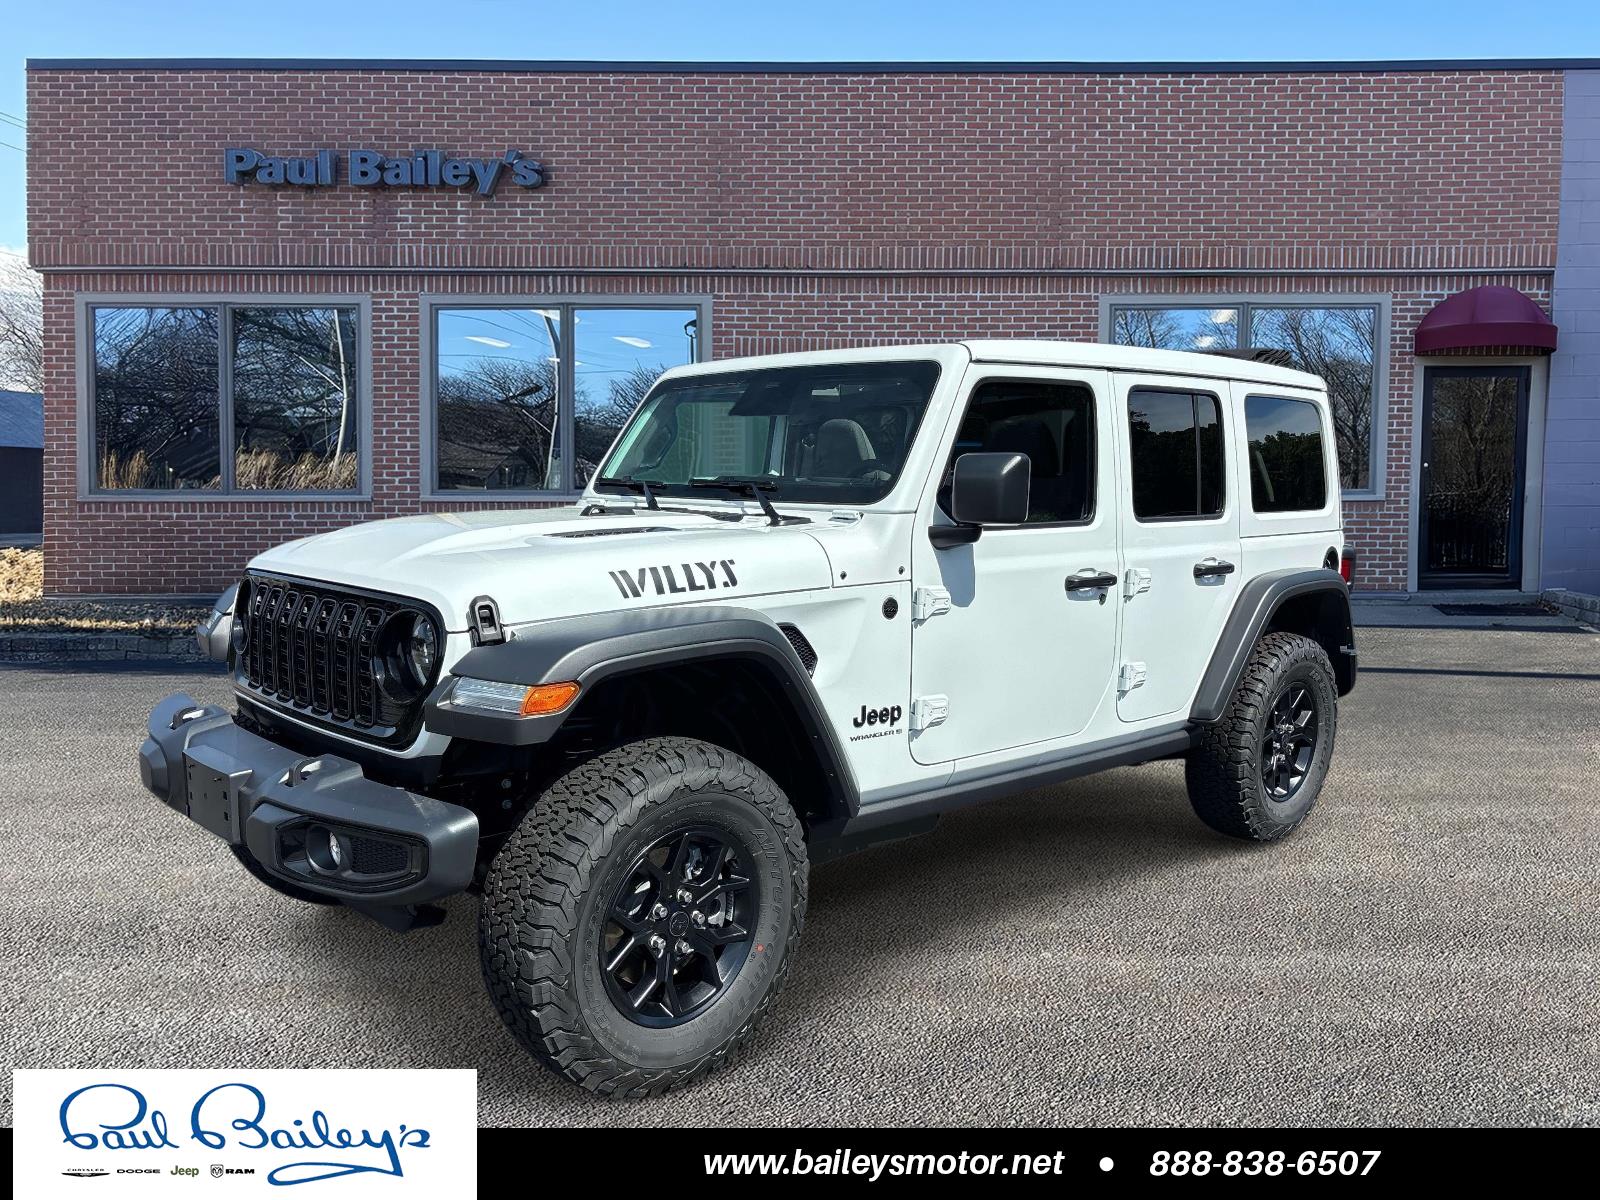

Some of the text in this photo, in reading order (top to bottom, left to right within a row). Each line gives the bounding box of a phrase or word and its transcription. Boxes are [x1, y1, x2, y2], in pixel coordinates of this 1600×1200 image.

[224, 148, 546, 196] Paul Bailey's
[608, 559, 738, 598] WILLYS
[853, 704, 902, 728] Jeep
[849, 730, 895, 742] WRANGLER
